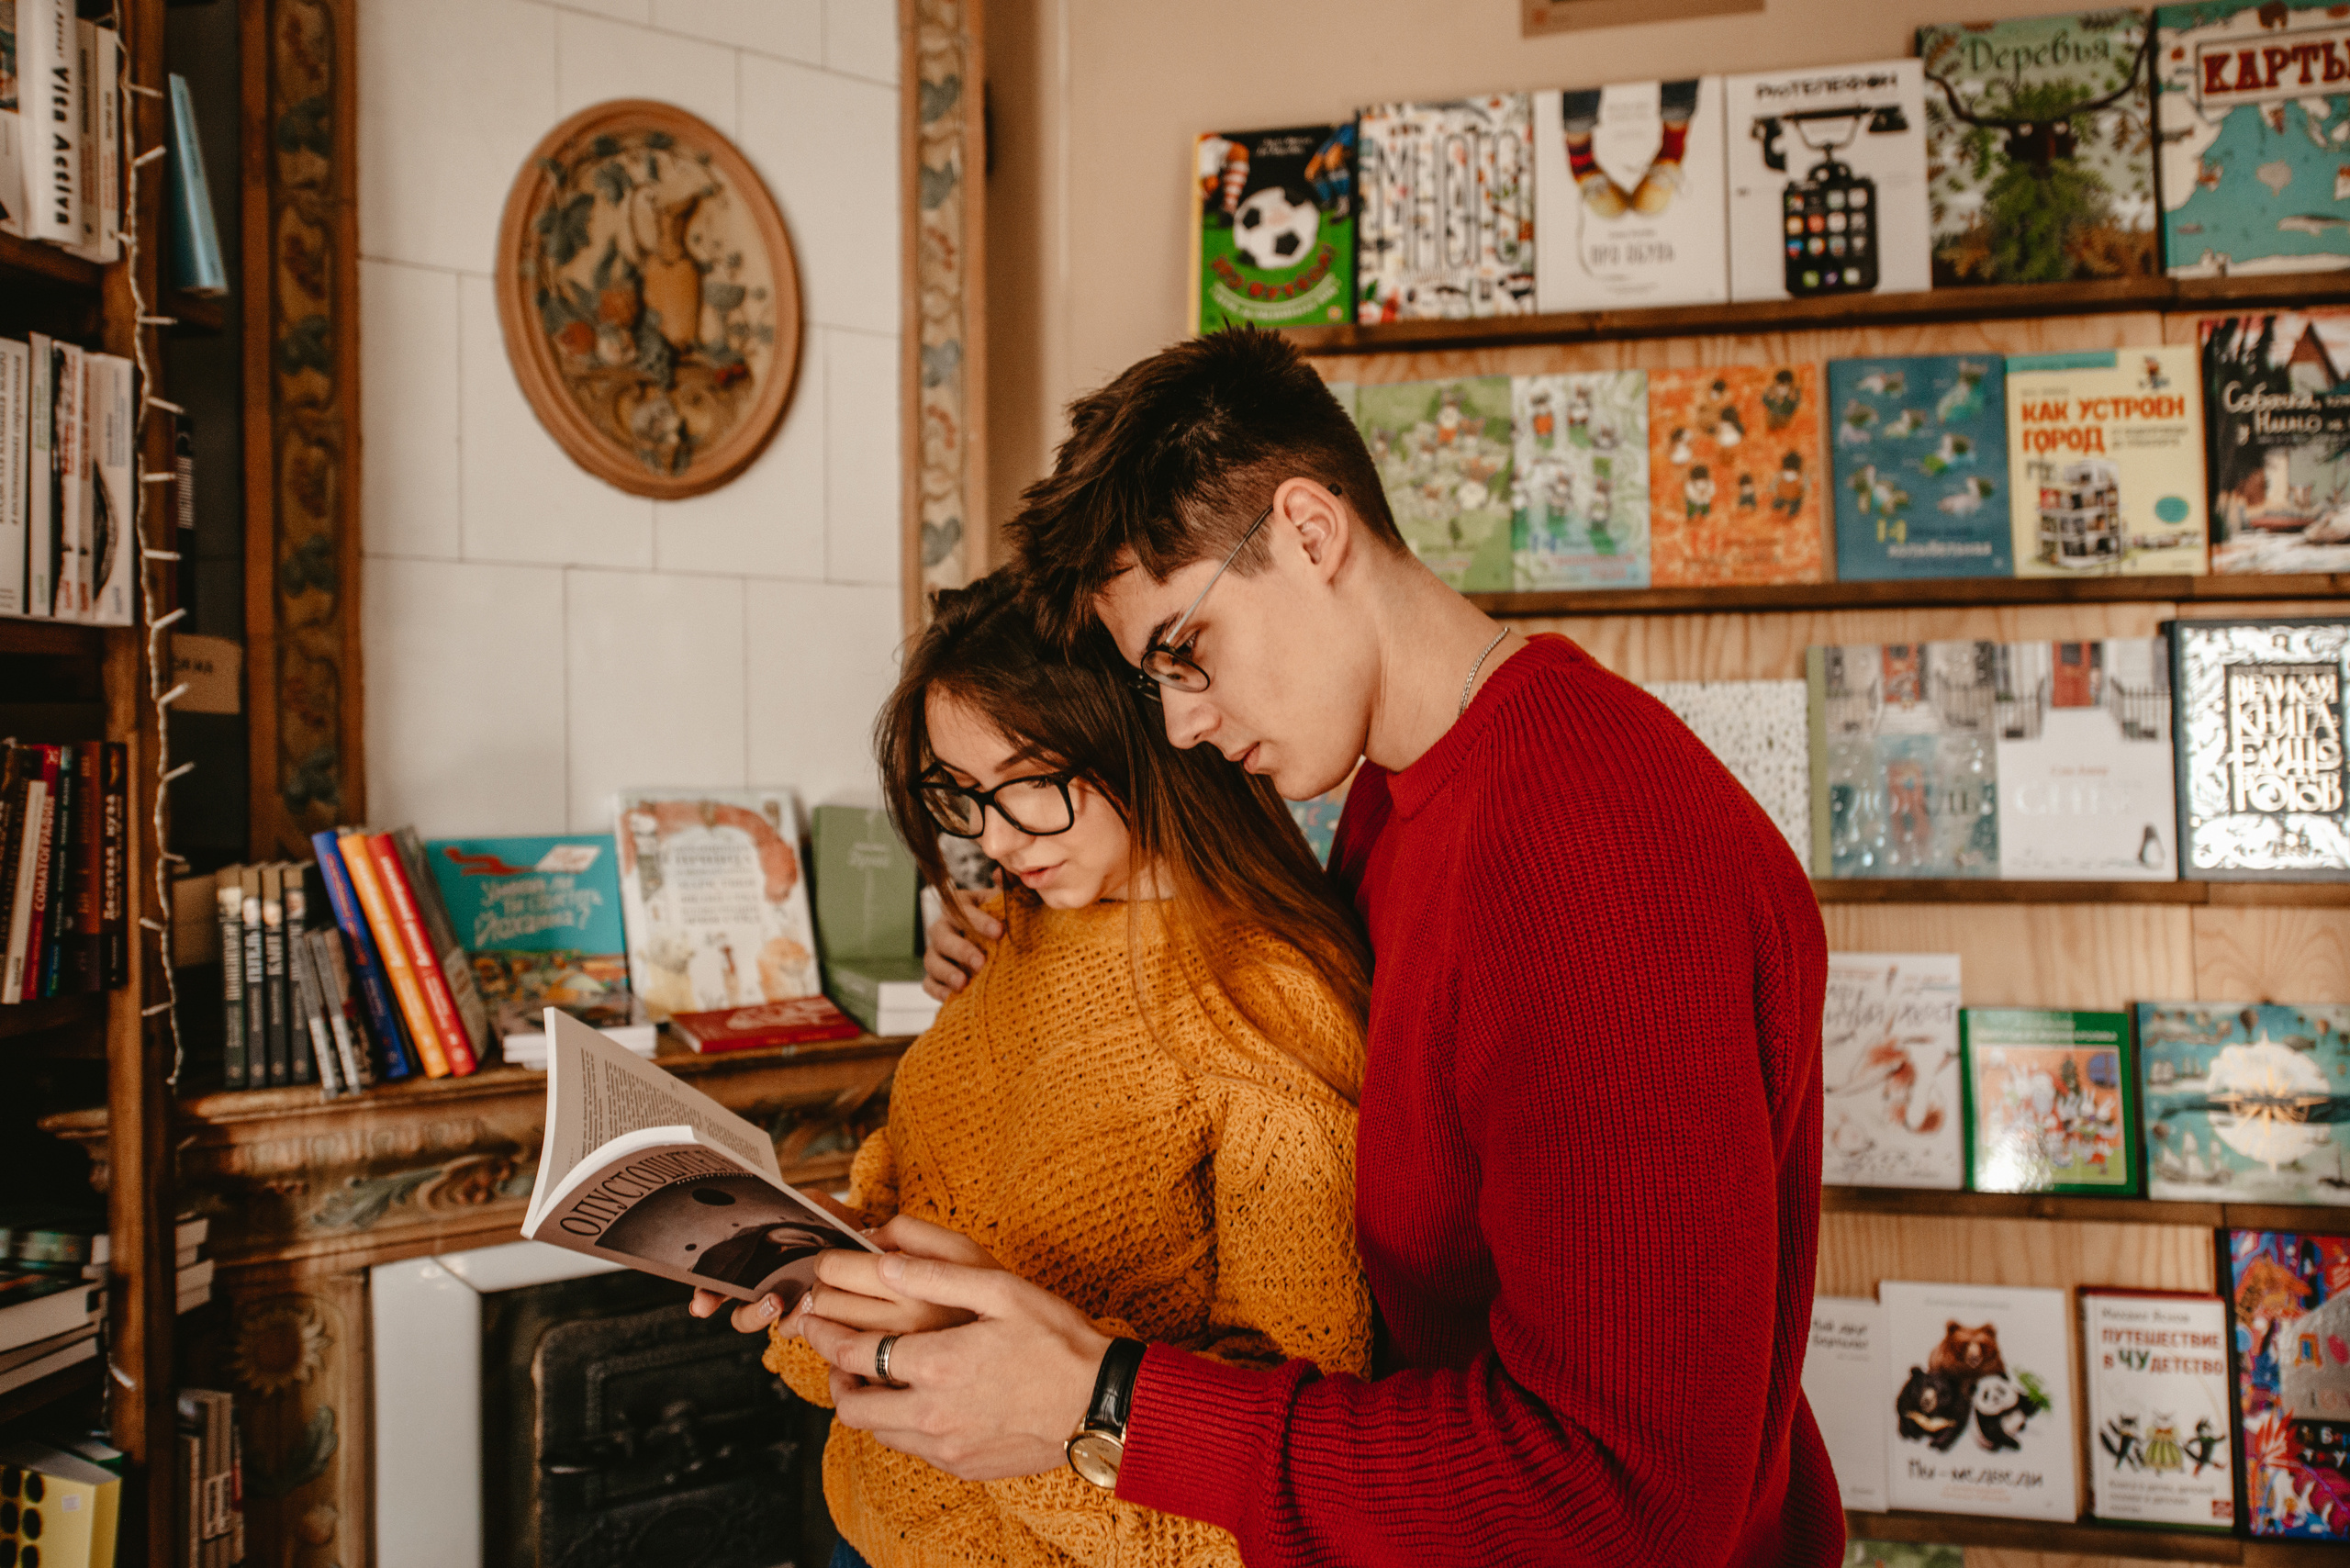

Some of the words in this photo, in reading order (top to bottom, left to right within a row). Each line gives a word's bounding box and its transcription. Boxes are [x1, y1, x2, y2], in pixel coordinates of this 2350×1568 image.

[1963, 30, 2110, 75] Деревья
[2203, 40, 2350, 95] КАРТЫ
[51, 66, 71, 122] Vita
[53, 133, 72, 225] Activa
[2021, 400, 2068, 422] КАК
[2078, 394, 2185, 422] УСТРОЕН
[2255, 409, 2322, 434] Нино
[2022, 426, 2106, 454] ГОРОД
[2231, 673, 2339, 705] ВЕЛИКАЯ
[2231, 702, 2342, 739] КНИГА
[2102, 1327, 2221, 1350] ПУТЕШЕСТВИЕ
[2104, 1352, 2114, 1369] В
[2119, 1349, 2223, 1375] ЧУДЕТСТВО
